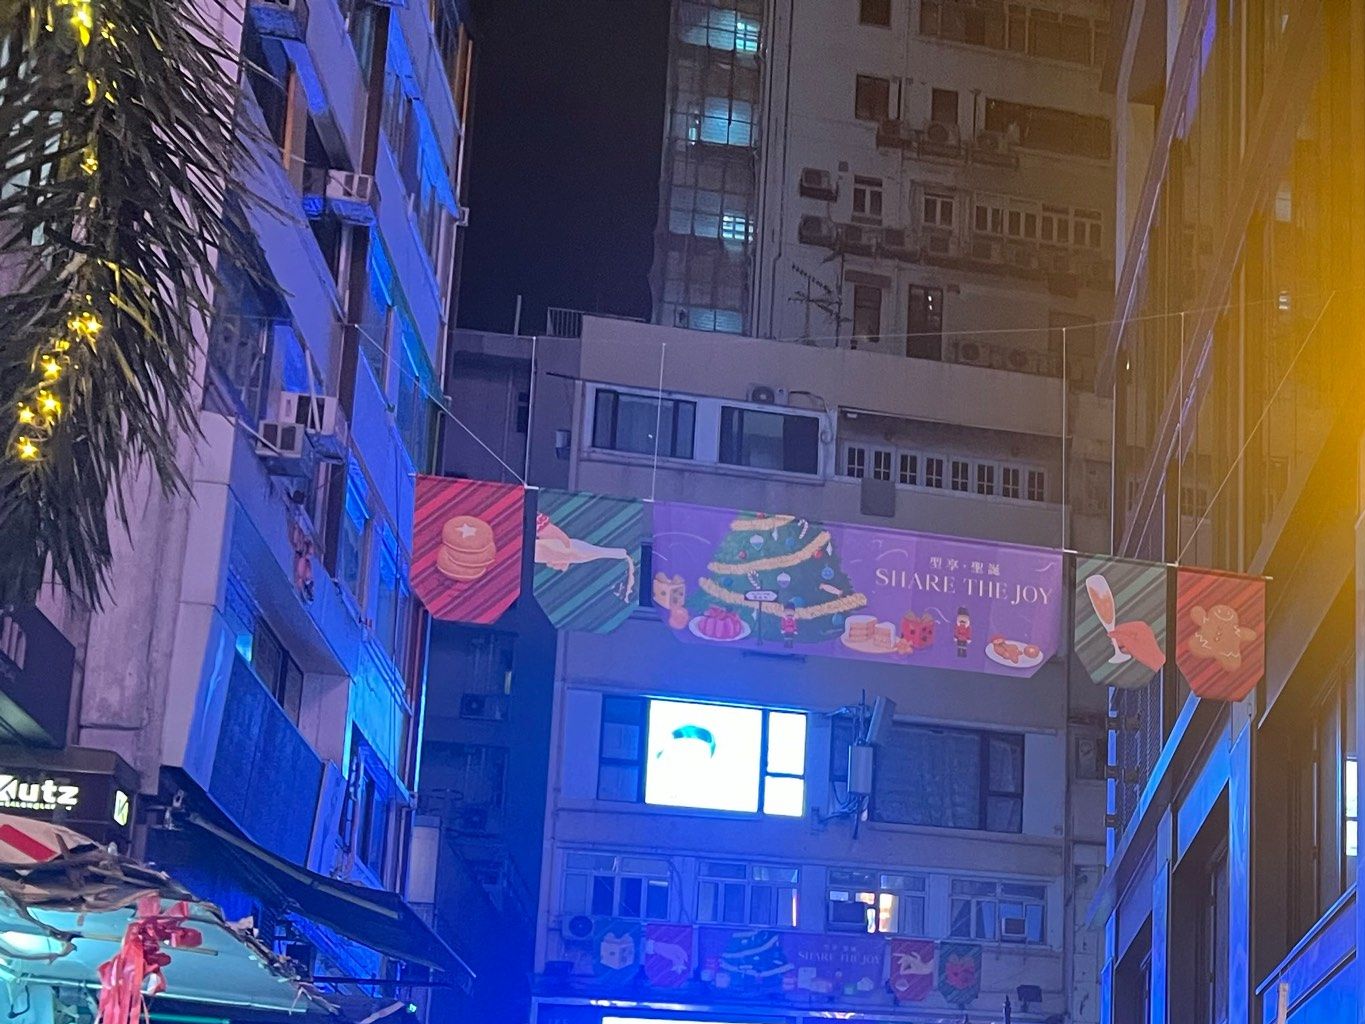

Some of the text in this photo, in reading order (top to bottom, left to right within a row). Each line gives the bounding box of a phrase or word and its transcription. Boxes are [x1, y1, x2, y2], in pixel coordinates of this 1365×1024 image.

[875, 568, 1052, 605] SHARE THE JOY
